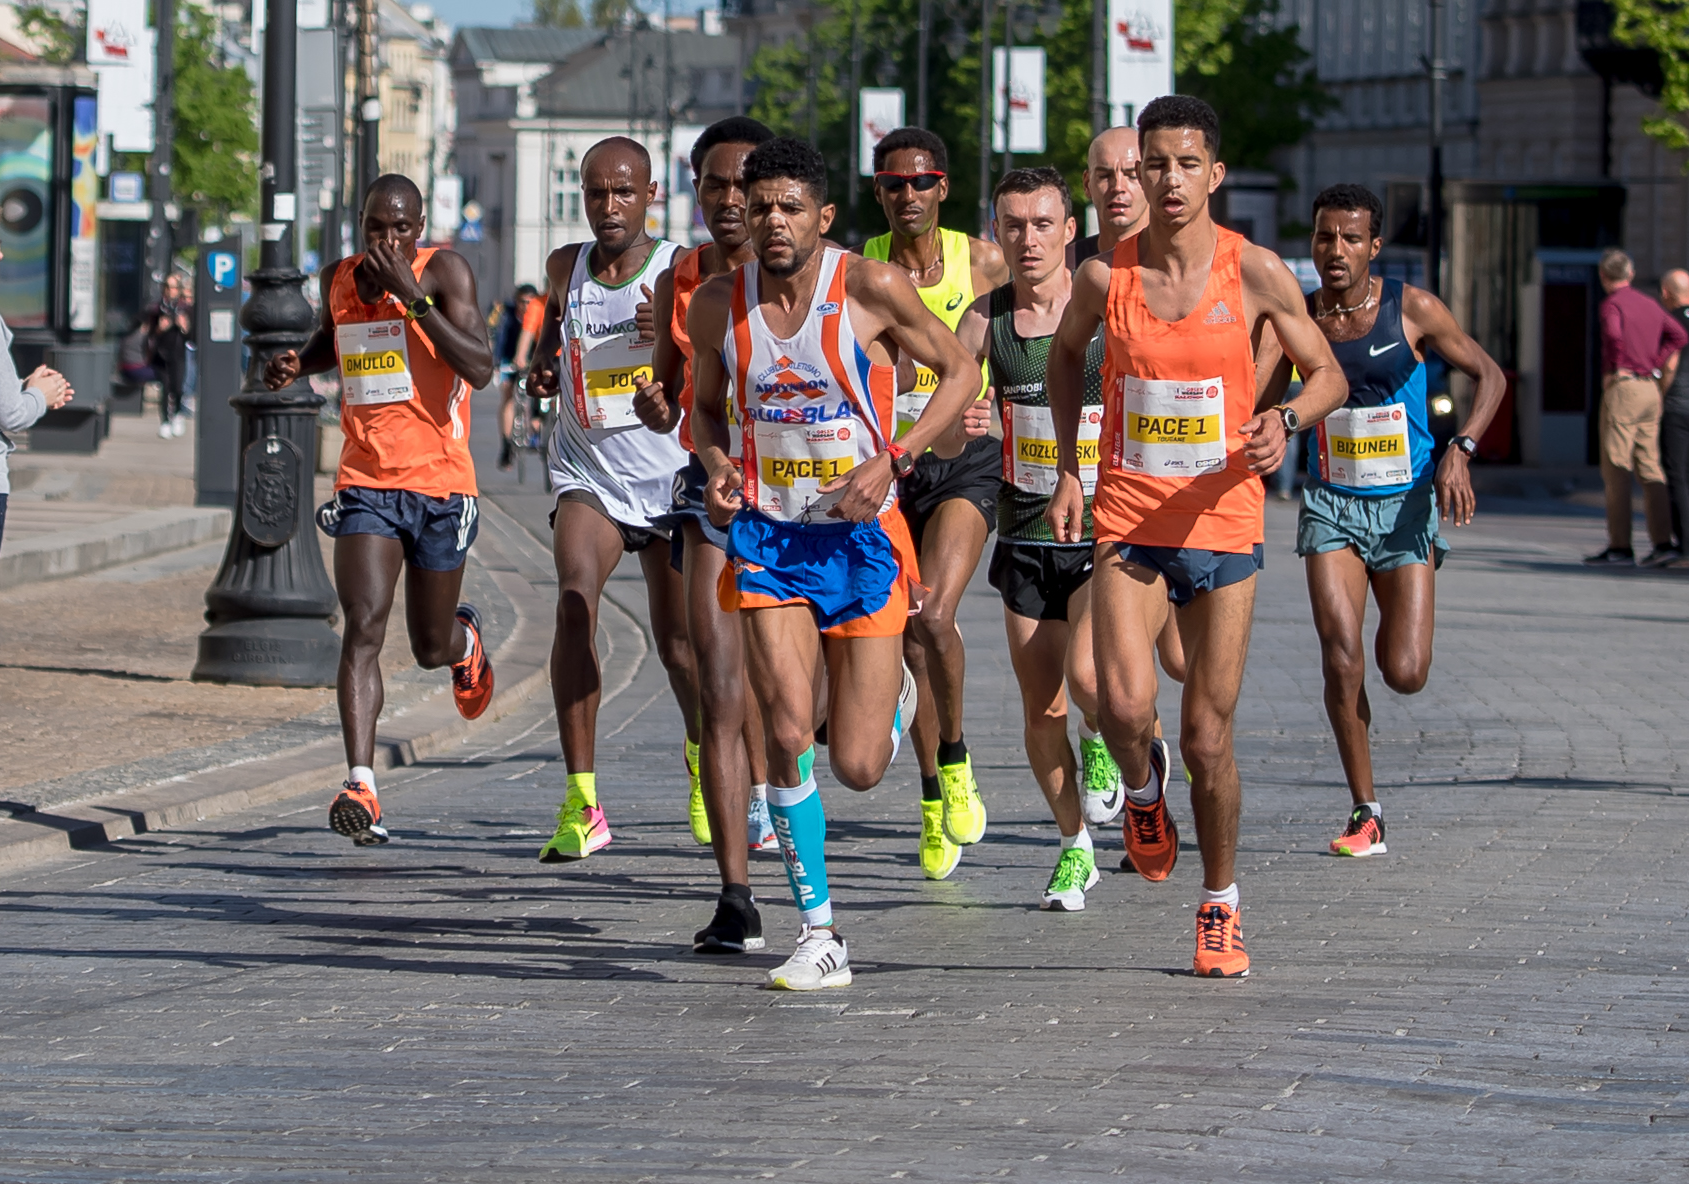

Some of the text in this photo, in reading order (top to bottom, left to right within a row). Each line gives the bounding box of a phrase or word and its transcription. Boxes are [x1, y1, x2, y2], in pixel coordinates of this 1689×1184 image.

[215, 254, 234, 283] P
[346, 355, 395, 372] OMULLO
[1137, 416, 1207, 436] PACE 1
[1020, 441, 1096, 459] KOZŁOSKI
[1336, 439, 1398, 456] BIZUNEH
[772, 460, 841, 478] PACE 1
